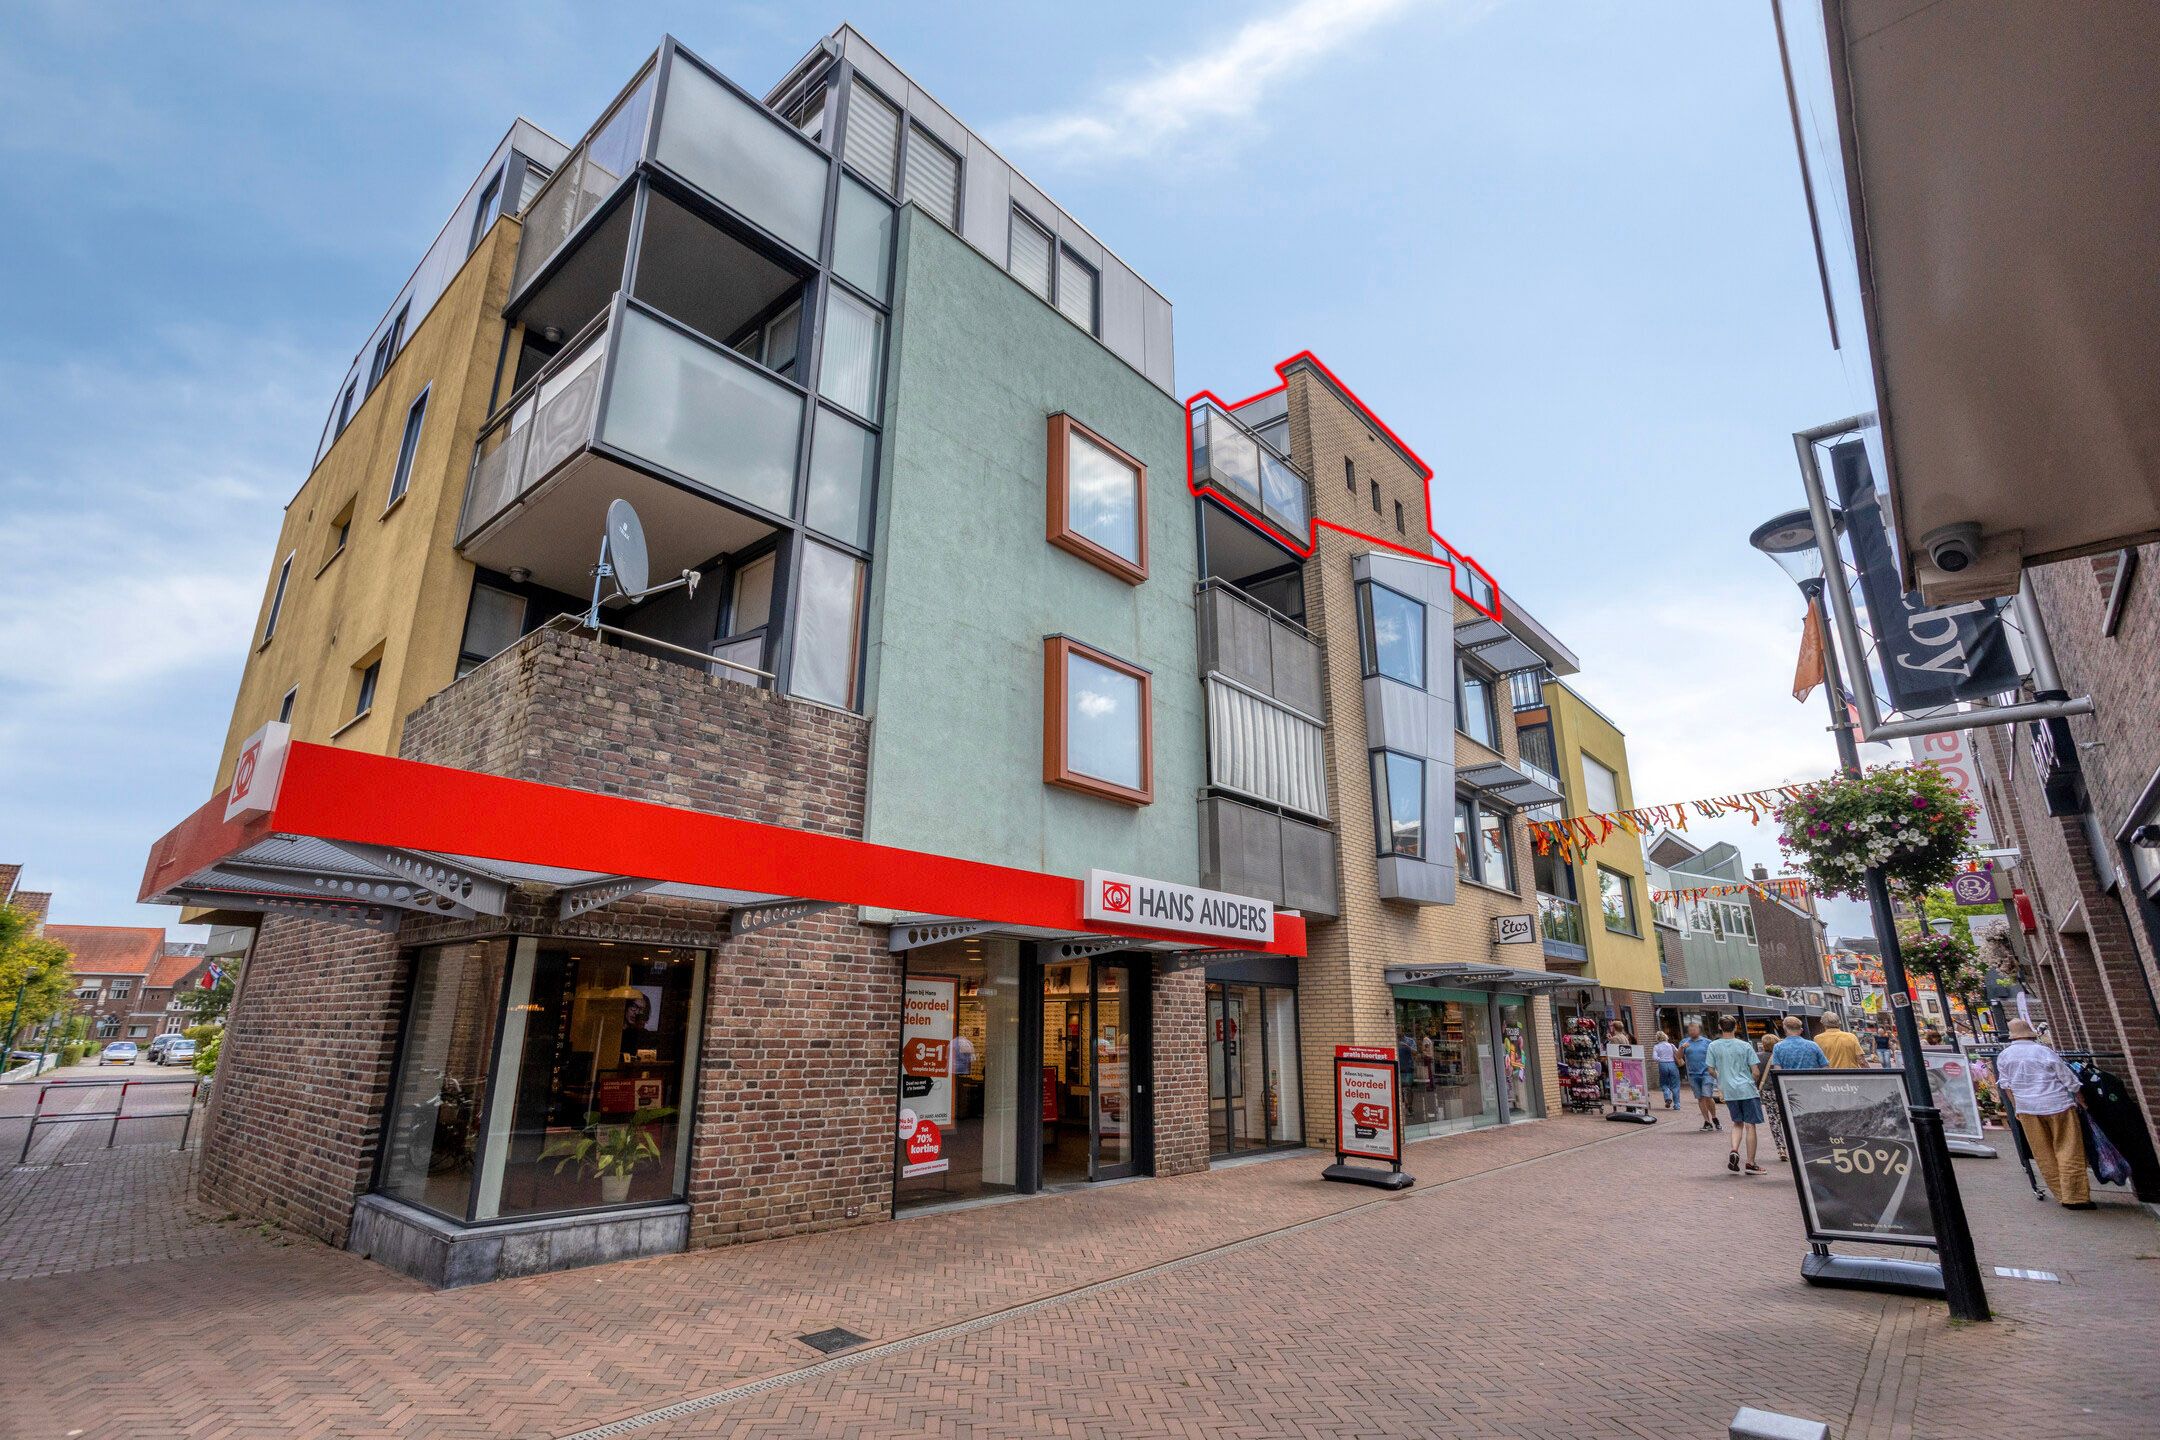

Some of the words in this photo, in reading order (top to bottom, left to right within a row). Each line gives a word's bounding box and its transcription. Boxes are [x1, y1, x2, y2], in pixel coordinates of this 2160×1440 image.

[1139, 886, 1194, 923] HANS
[1200, 898, 1267, 933] ANDERS
[1501, 919, 1528, 935] Etos
[904, 998, 949, 1011] Voordeel
[904, 1013, 931, 1025] delen
[1344, 1078, 1386, 1089] Voordeel
[1344, 1089, 1370, 1099] delen
[916, 1134, 932, 1143] 70%
[1829, 1136, 1844, 1145] tot
[911, 1144, 938, 1154] korting
[1816, 1149, 1908, 1176] -50%
